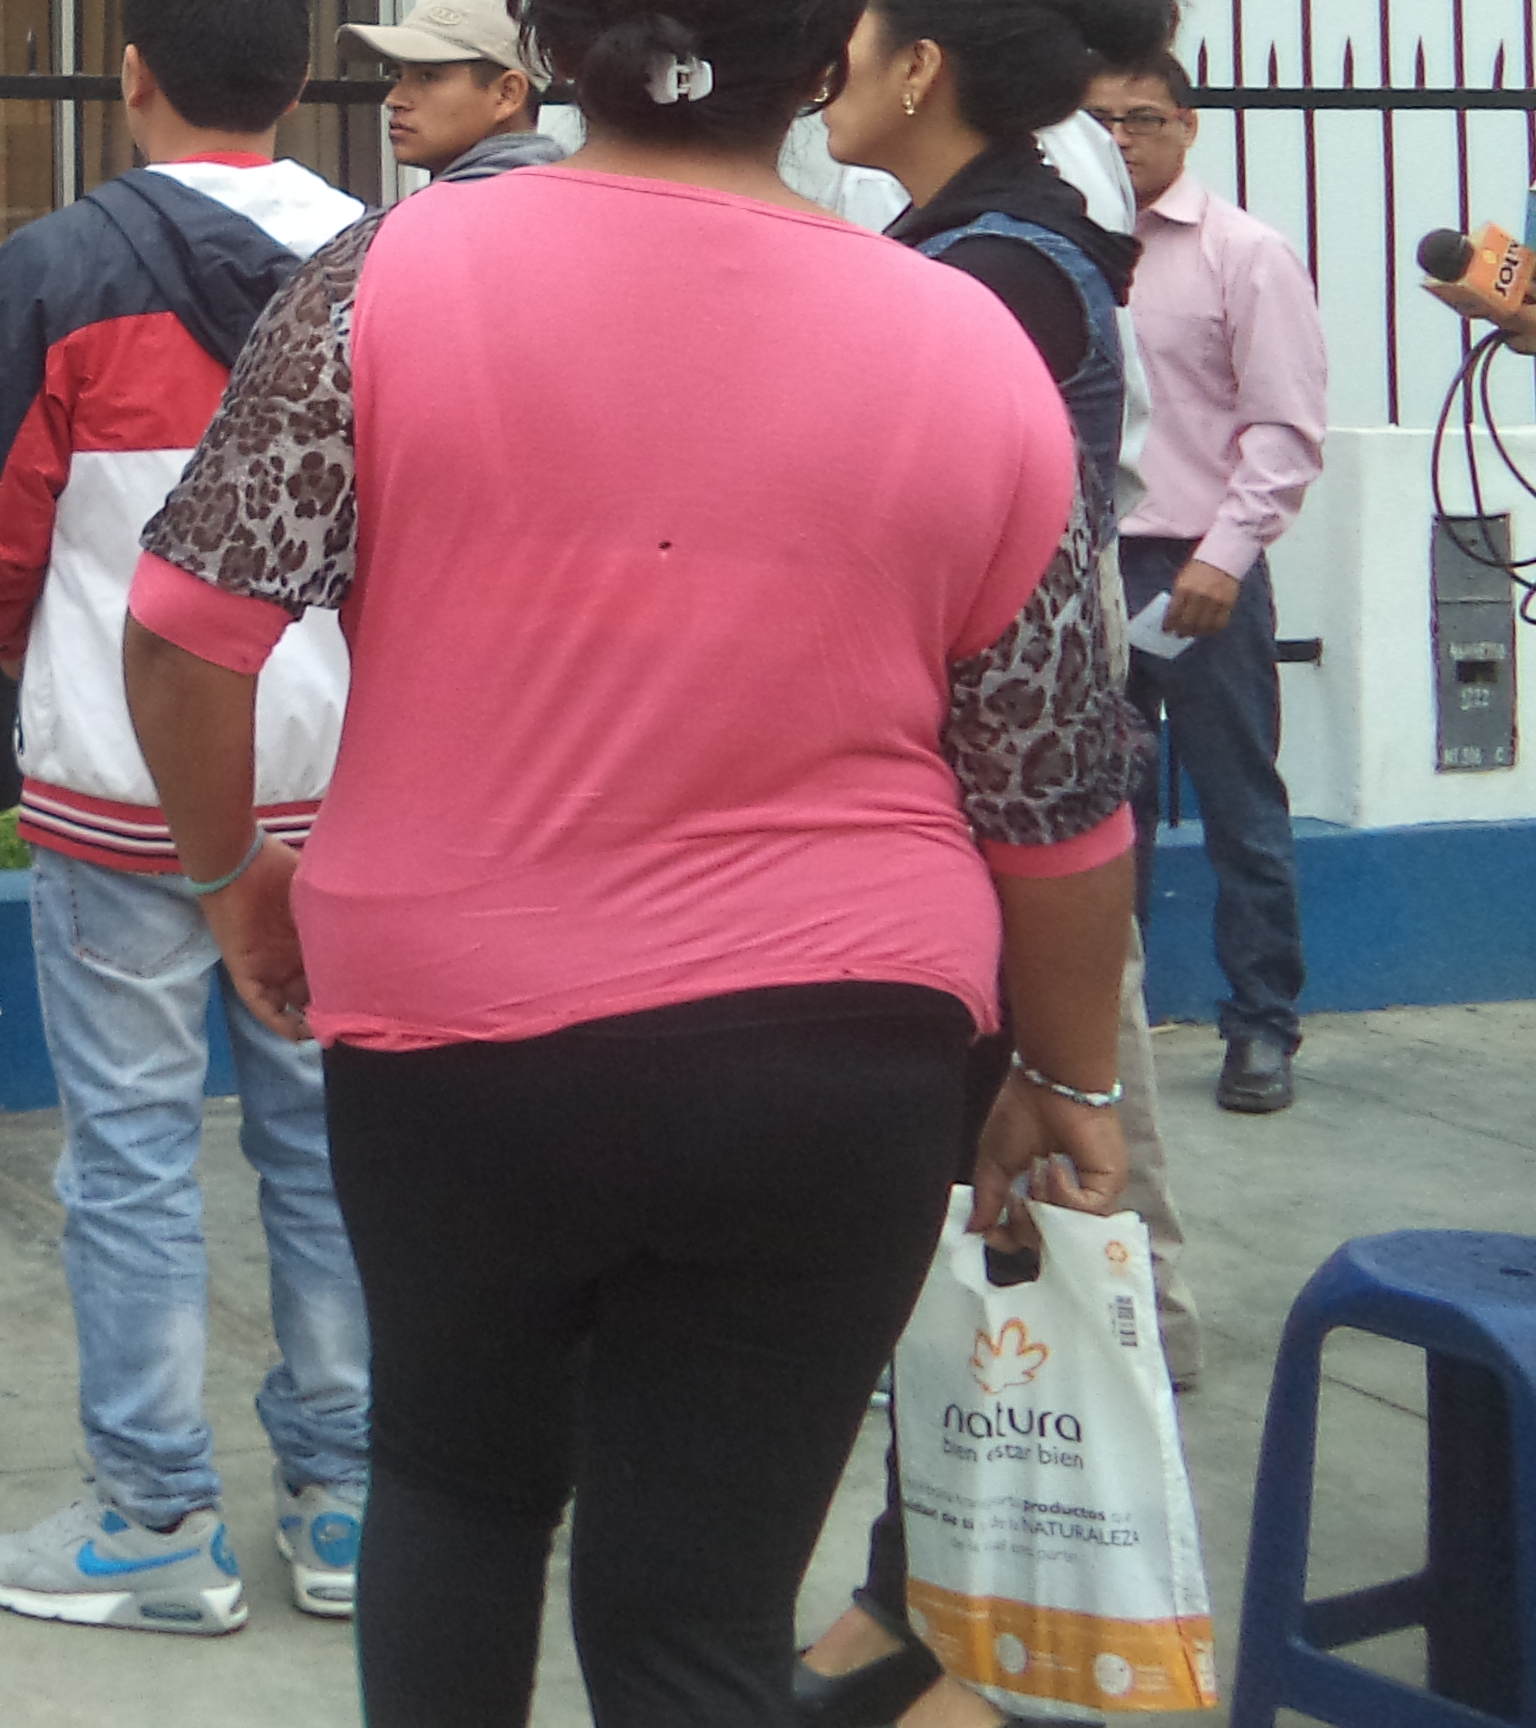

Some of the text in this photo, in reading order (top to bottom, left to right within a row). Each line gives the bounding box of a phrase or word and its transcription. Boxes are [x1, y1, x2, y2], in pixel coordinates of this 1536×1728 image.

[942, 1400, 1083, 1444] natura
[1037, 1443, 1084, 1471] bien
[1023, 1499, 1107, 1522] productos
